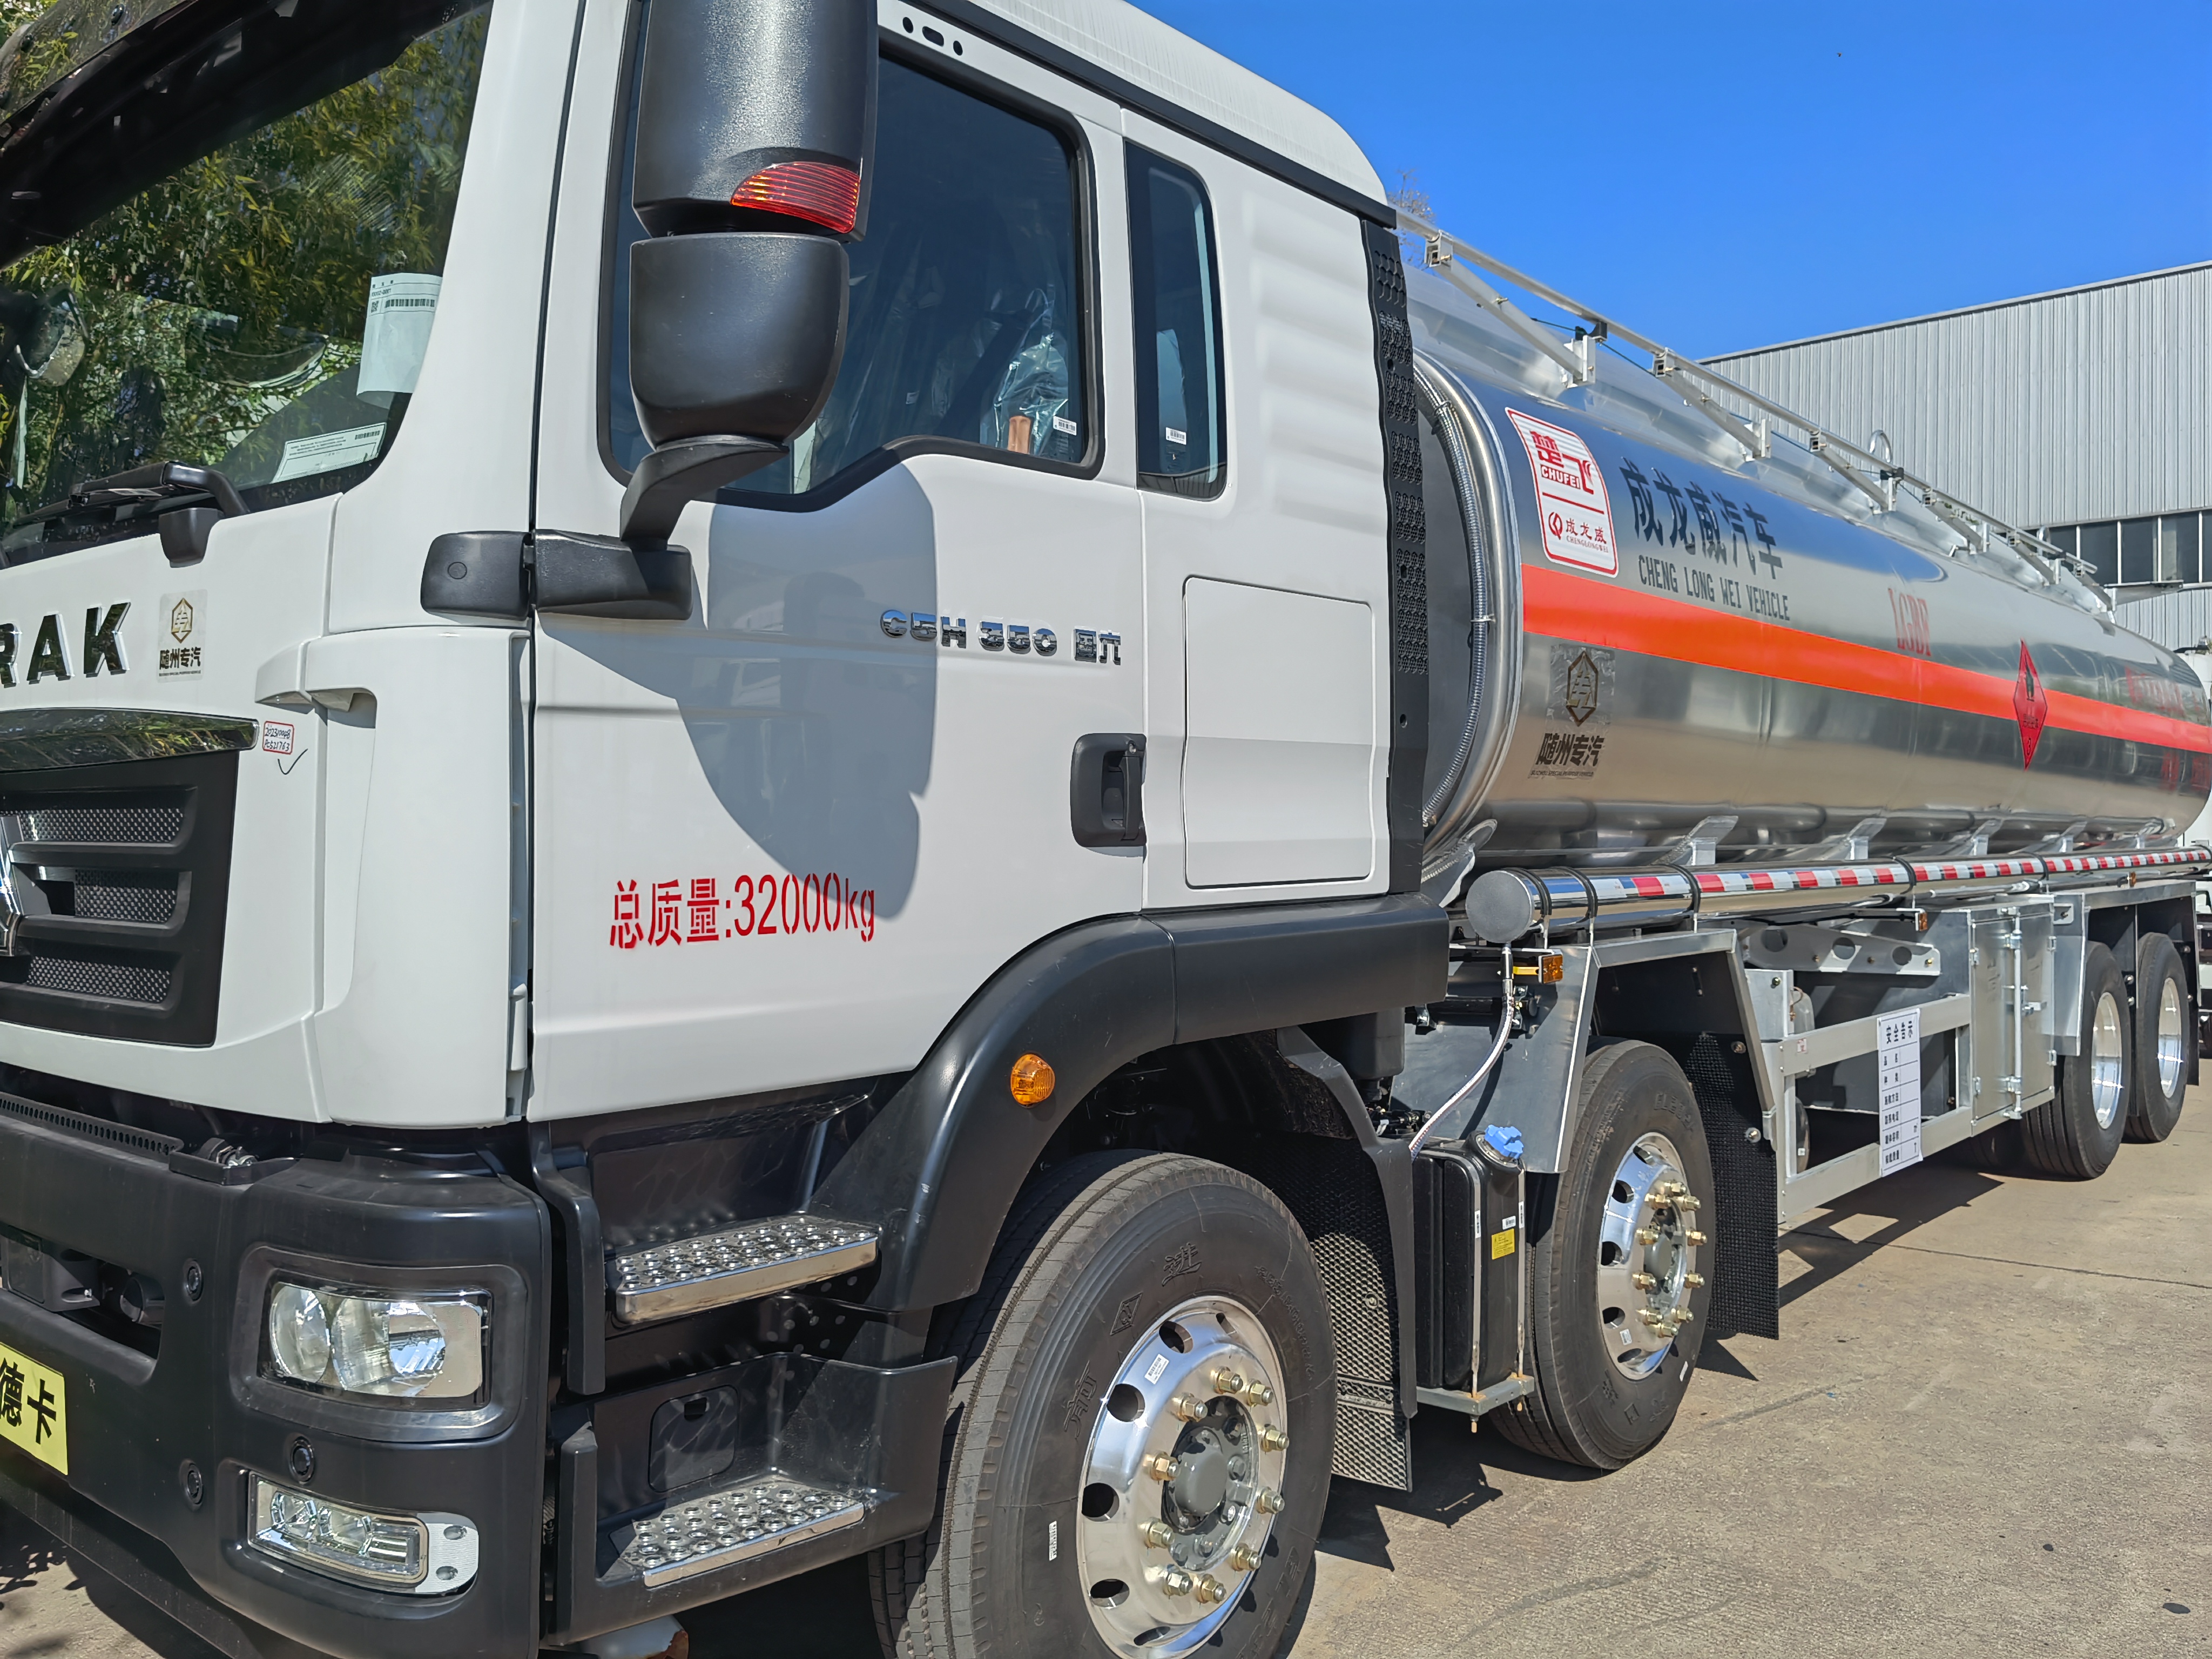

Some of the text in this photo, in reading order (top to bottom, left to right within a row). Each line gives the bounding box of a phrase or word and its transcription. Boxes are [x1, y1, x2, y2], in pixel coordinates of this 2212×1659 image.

[1541, 464, 1581, 489] CHUFEI
[1566, 517, 1607, 544] 成龙威
[1619, 457, 1783, 579] 成龙威汽车
[1566, 536, 1609, 553] CHENGLONGWEI
[1638, 555, 1790, 621] CHENG LONG WEI VEHICLE
[880, 609, 1121, 665] C5H 350 国六
[159, 646, 201, 670] 随州专汽
[1535, 733, 1605, 767] 随州专汽
[1886, 1021, 1913, 1044] 安全告示
